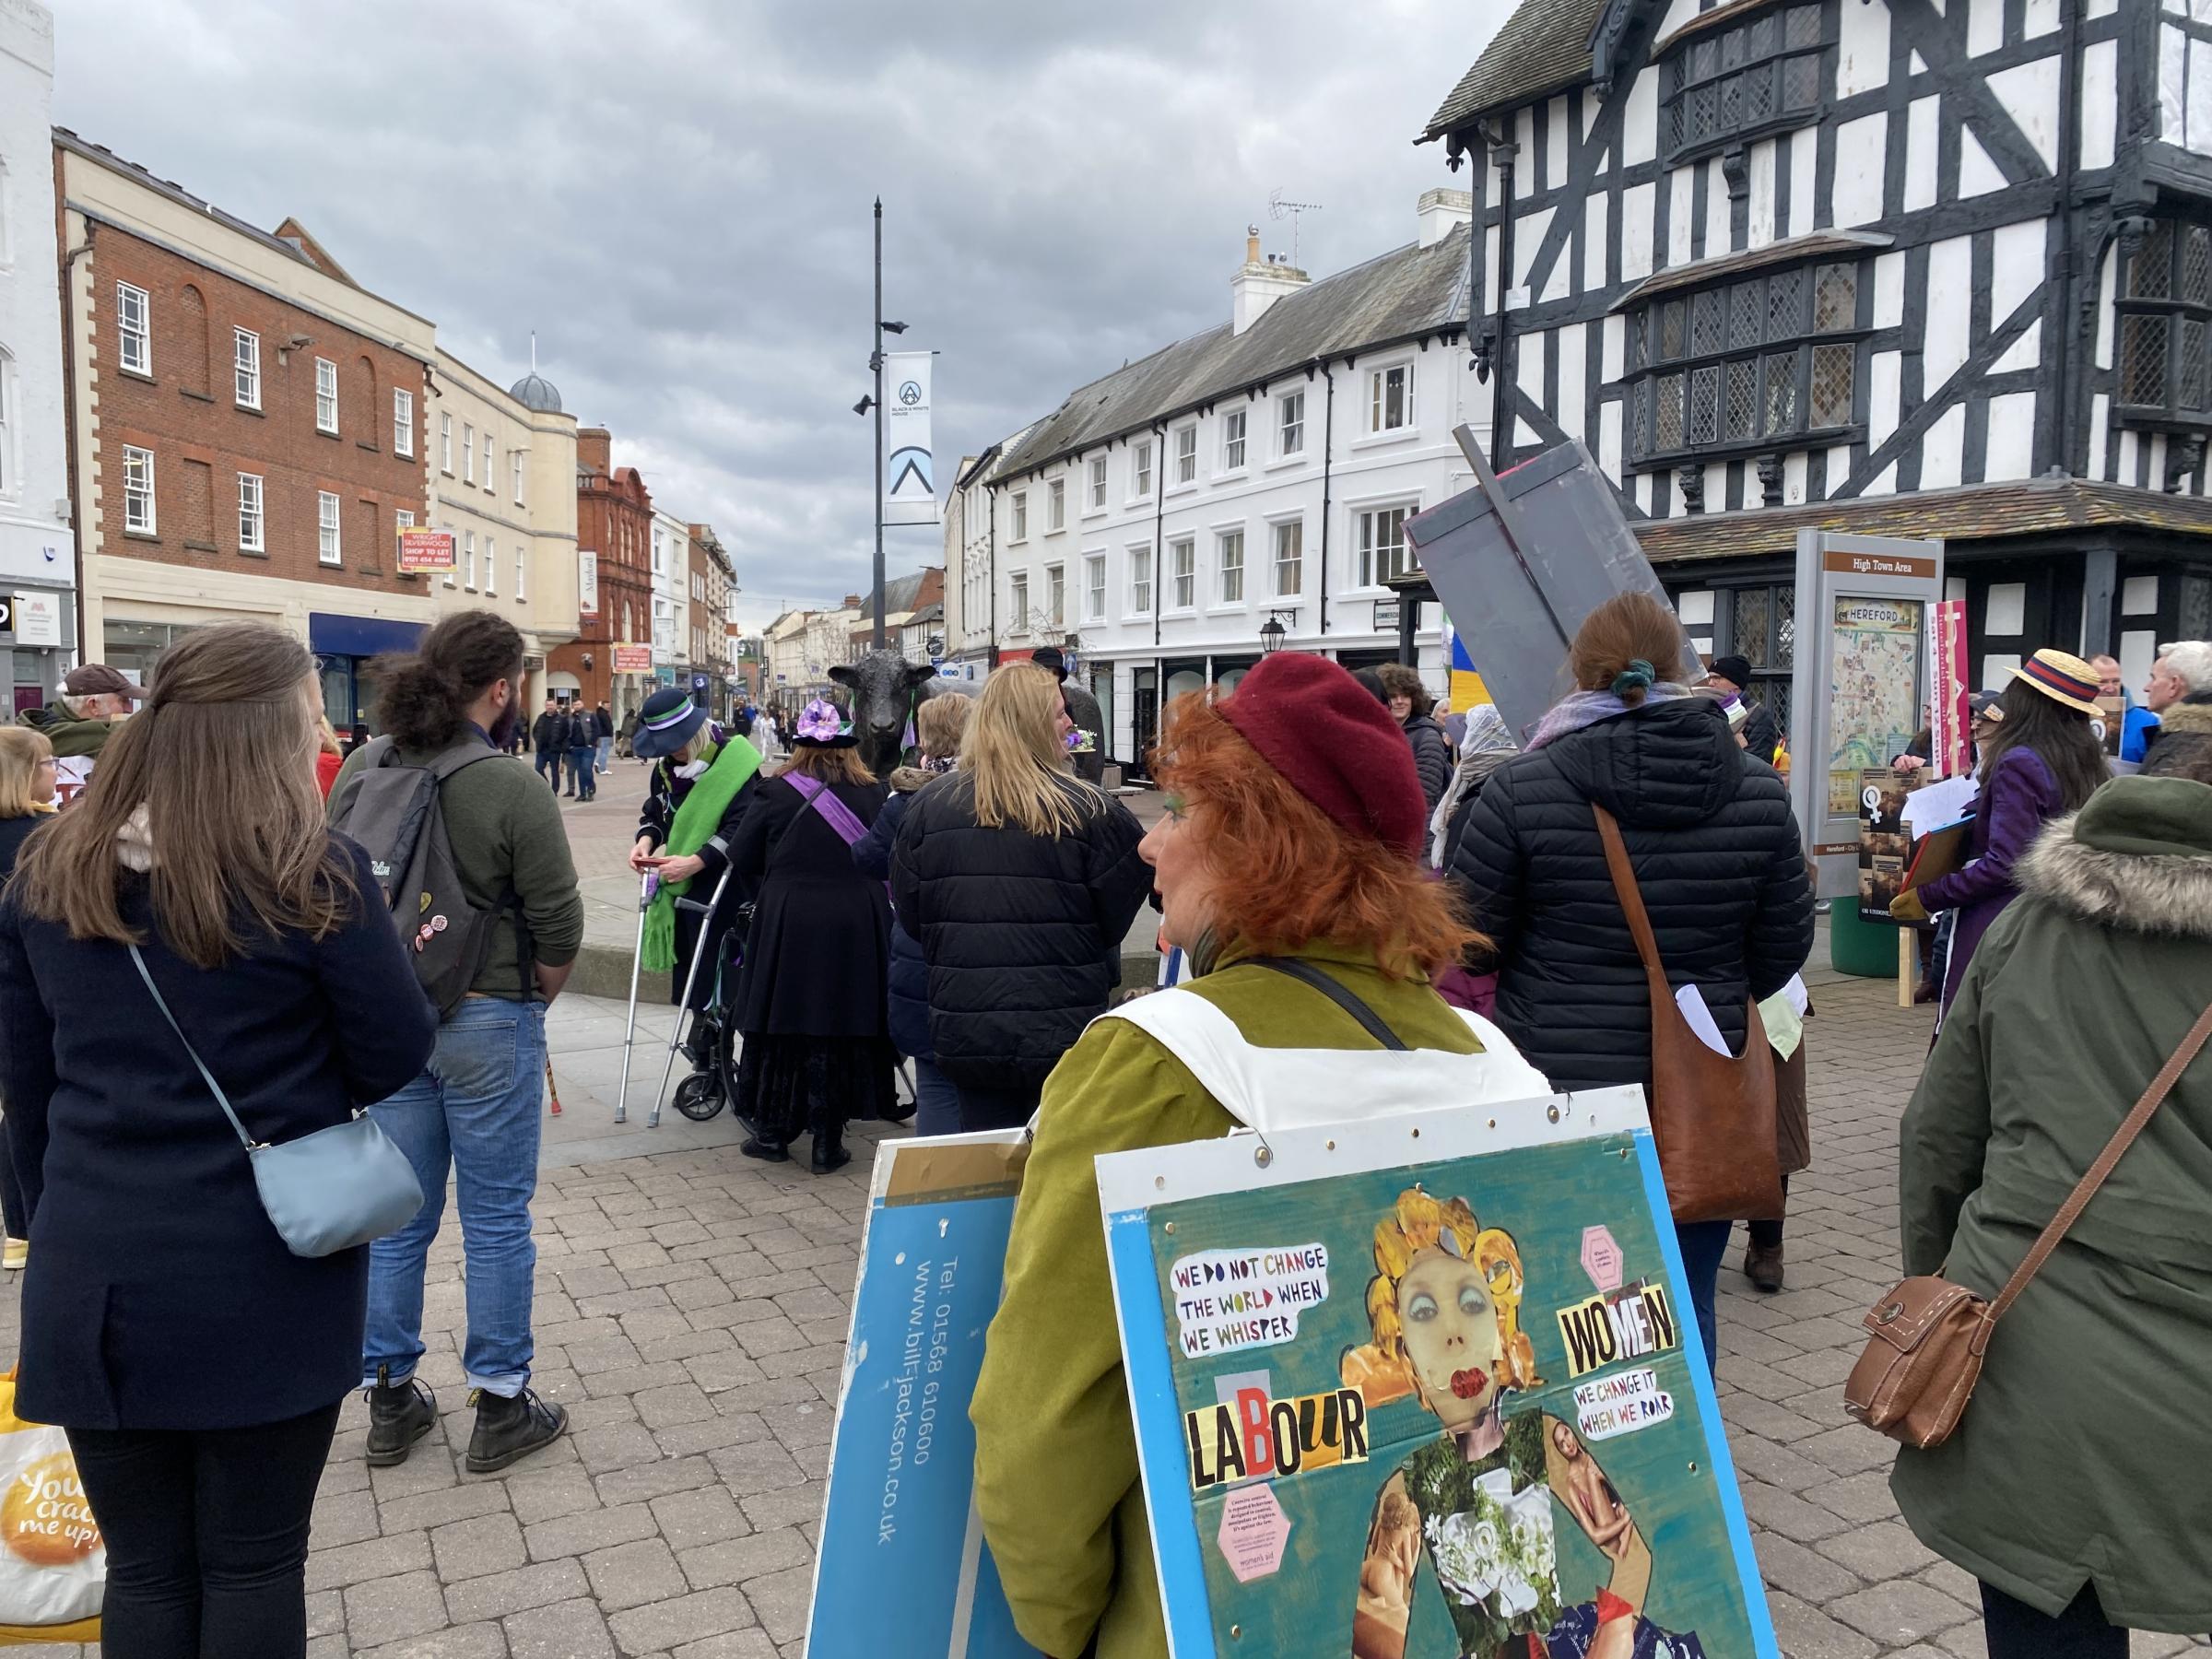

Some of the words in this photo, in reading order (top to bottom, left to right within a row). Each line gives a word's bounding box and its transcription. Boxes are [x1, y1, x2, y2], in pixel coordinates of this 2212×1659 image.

[437, 547, 449, 556] LET
[1853, 558, 1871, 571] High
[1873, 559, 1893, 571] Town
[1894, 561, 1912, 572] Area
[584, 558, 594, 592] Mayford
[1850, 608, 1898, 622] HEREFORD
[1935, 708, 1939, 725] 12
[938, 1255, 959, 1296] Tel:
[1175, 1265, 1201, 1288] WE
[1203, 1263, 1225, 1284] DO
[1230, 1257, 1259, 1280] NOT
[1264, 1247, 1326, 1276] CHANGE
[1180, 1298, 1214, 1320] THE
[1218, 1288, 1274, 1315] WORLD
[1277, 1279, 1323, 1304] WHEN
[927, 1303, 951, 1374] 01568
[1183, 1328, 1209, 1353] WE
[1216, 1316, 1292, 1347] WHISPER
[1561, 1289, 1674, 1374] WOMEN
[877, 1260, 933, 1547] www.bill-jackson.co.uk
[1575, 1386, 1595, 1406] WE
[1596, 1374, 1641, 1403] CHANGE
[1642, 1371, 1654, 1390] IT
[914, 1381, 940, 1466] 610600
[1580, 1409, 1617, 1434] WHEN
[1618, 1403, 1637, 1423] WE
[1641, 1394, 1671, 1419] ROAR
[20, 1470, 87, 1504] You
[1231, 1498, 1251, 1506] Coercive
[36, 1500, 96, 1525] crac
[1230, 1511, 1250, 1519] designed
[1232, 1504, 1251, 1512] repeated
[1251, 1500, 1273, 1508] behaviour
[19, 1519, 60, 1535] me
[65, 1524, 100, 1549] up!
[1240, 1553, 1264, 1566] women's
[1265, 1550, 1274, 1560] aid
